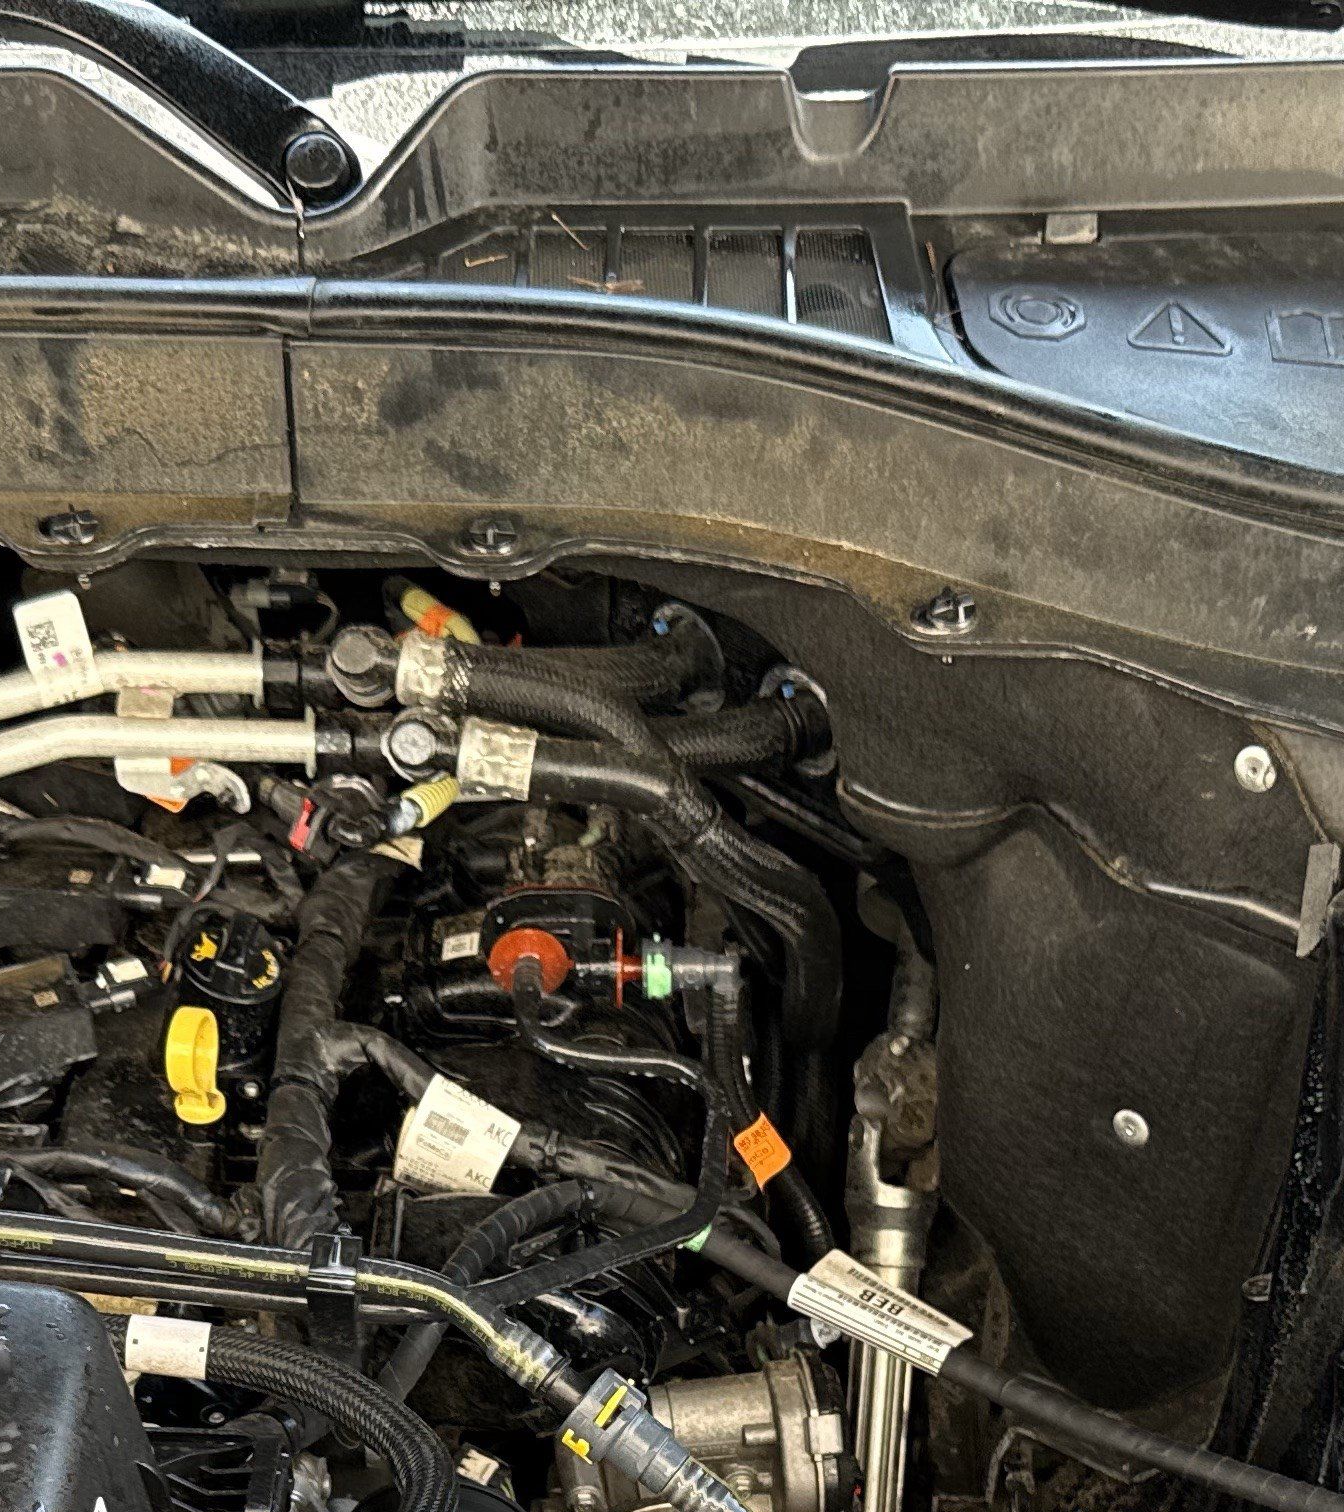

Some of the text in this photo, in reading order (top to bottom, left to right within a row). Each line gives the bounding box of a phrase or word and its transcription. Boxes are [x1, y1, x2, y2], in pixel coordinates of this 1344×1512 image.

[484, 1122, 514, 1148] AKC
[464, 1168, 492, 1189] AKC
[858, 1287, 906, 1317] BEB
